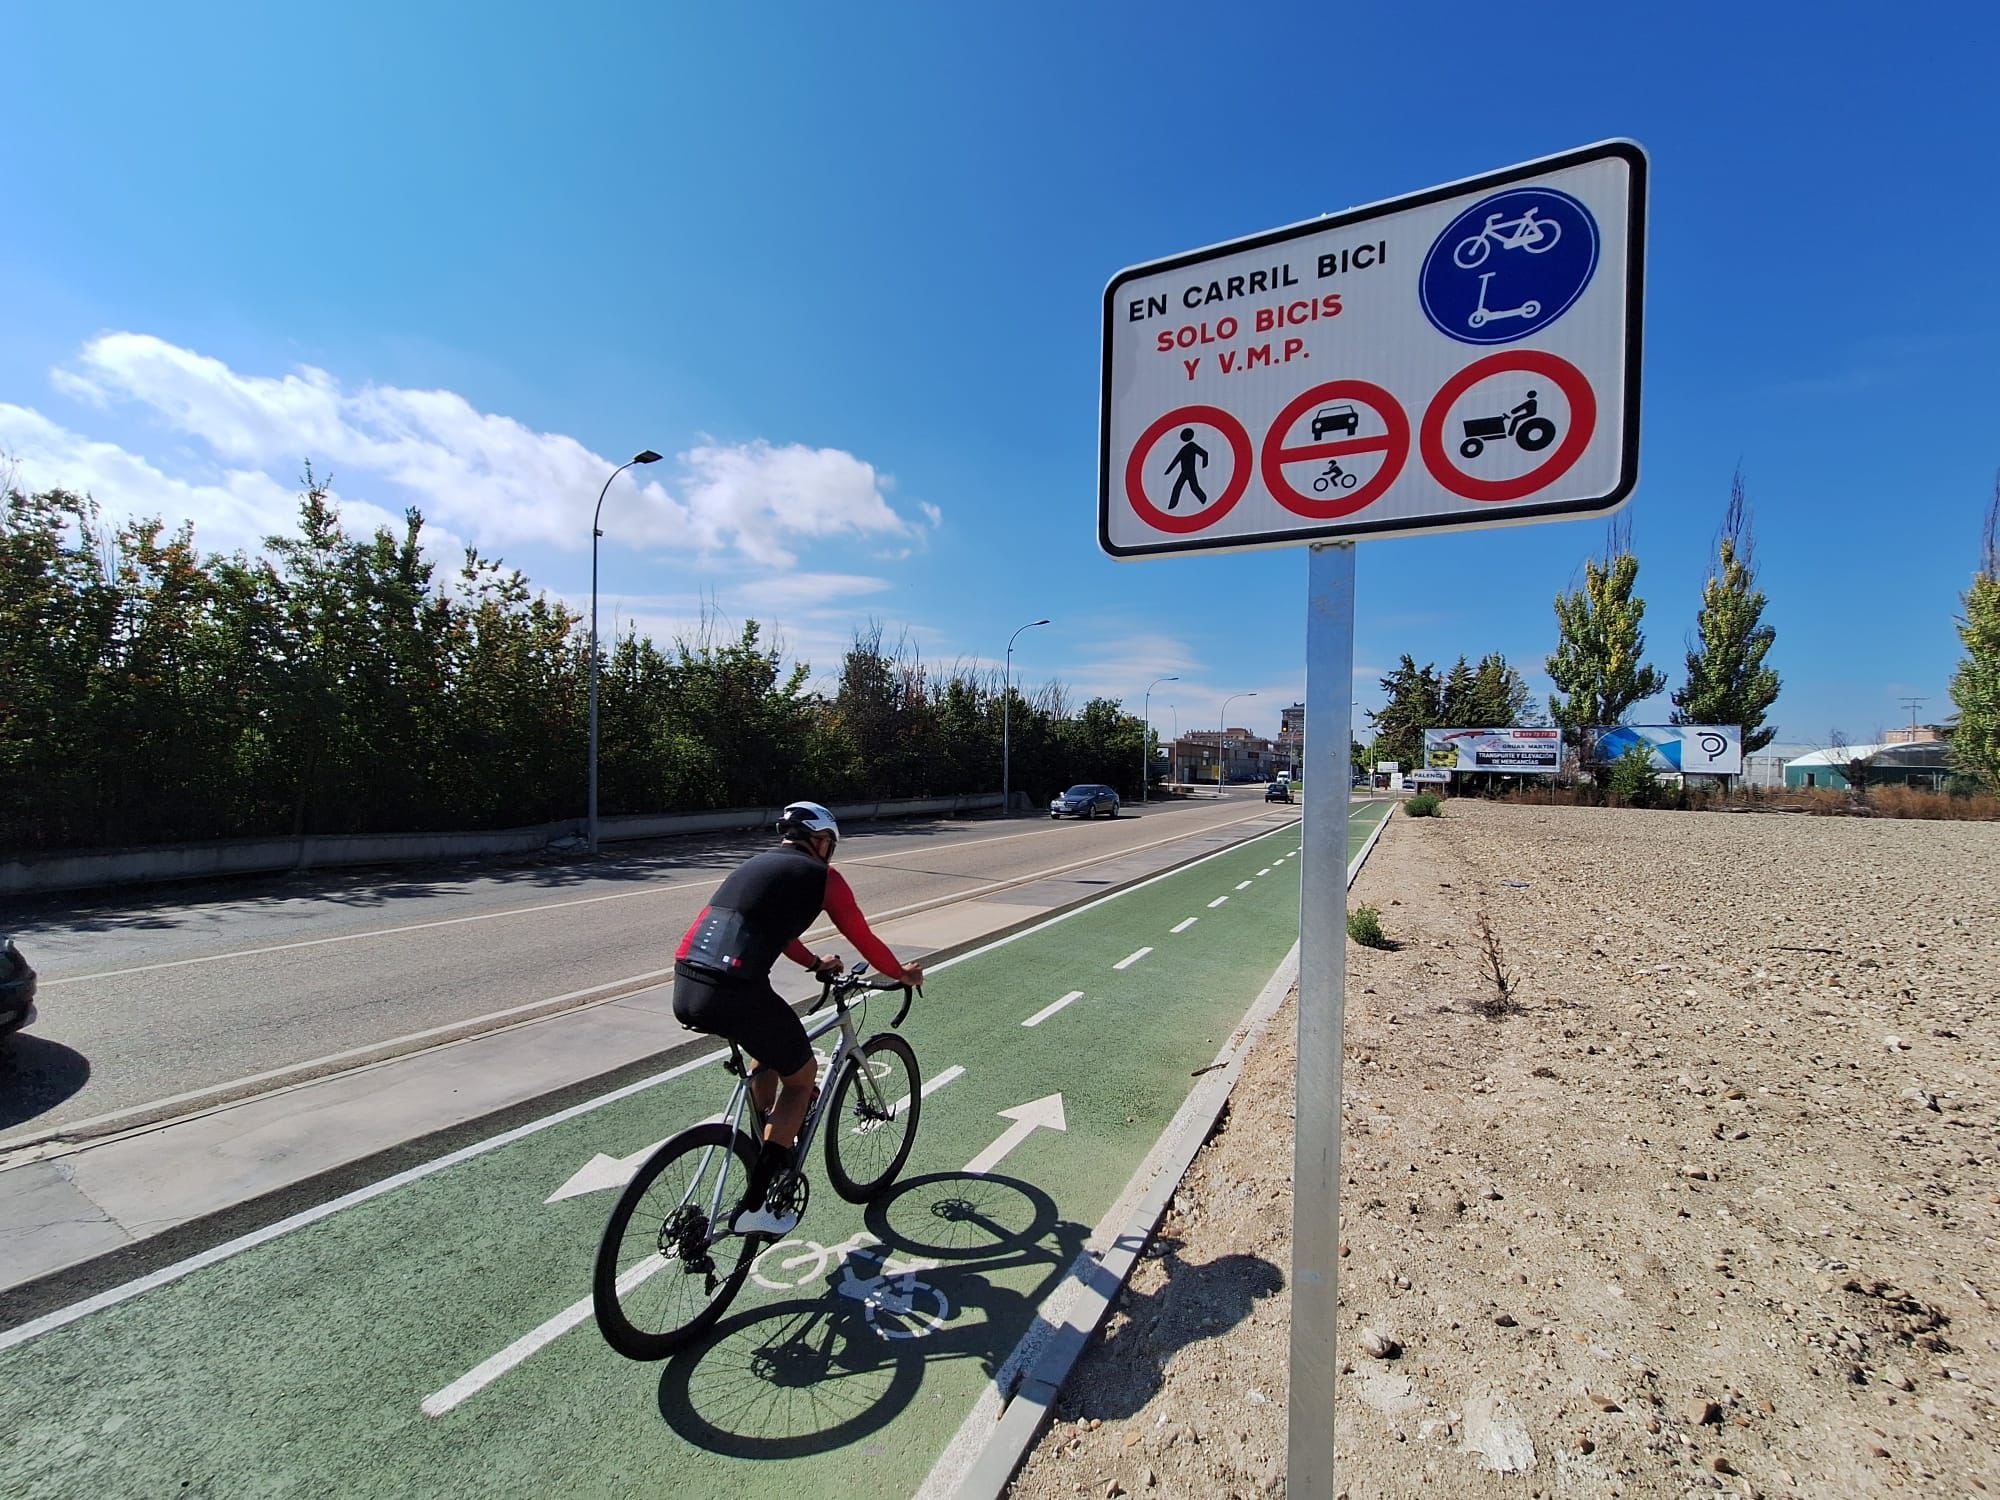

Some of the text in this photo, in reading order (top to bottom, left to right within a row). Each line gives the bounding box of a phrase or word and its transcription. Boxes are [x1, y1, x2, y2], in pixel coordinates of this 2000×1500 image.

[1129, 240, 1386, 322] EN CARRIL BICI
[1157, 294, 1343, 352] SOLO BICIS
[1183, 338, 1310, 381] Y V.M.P.
